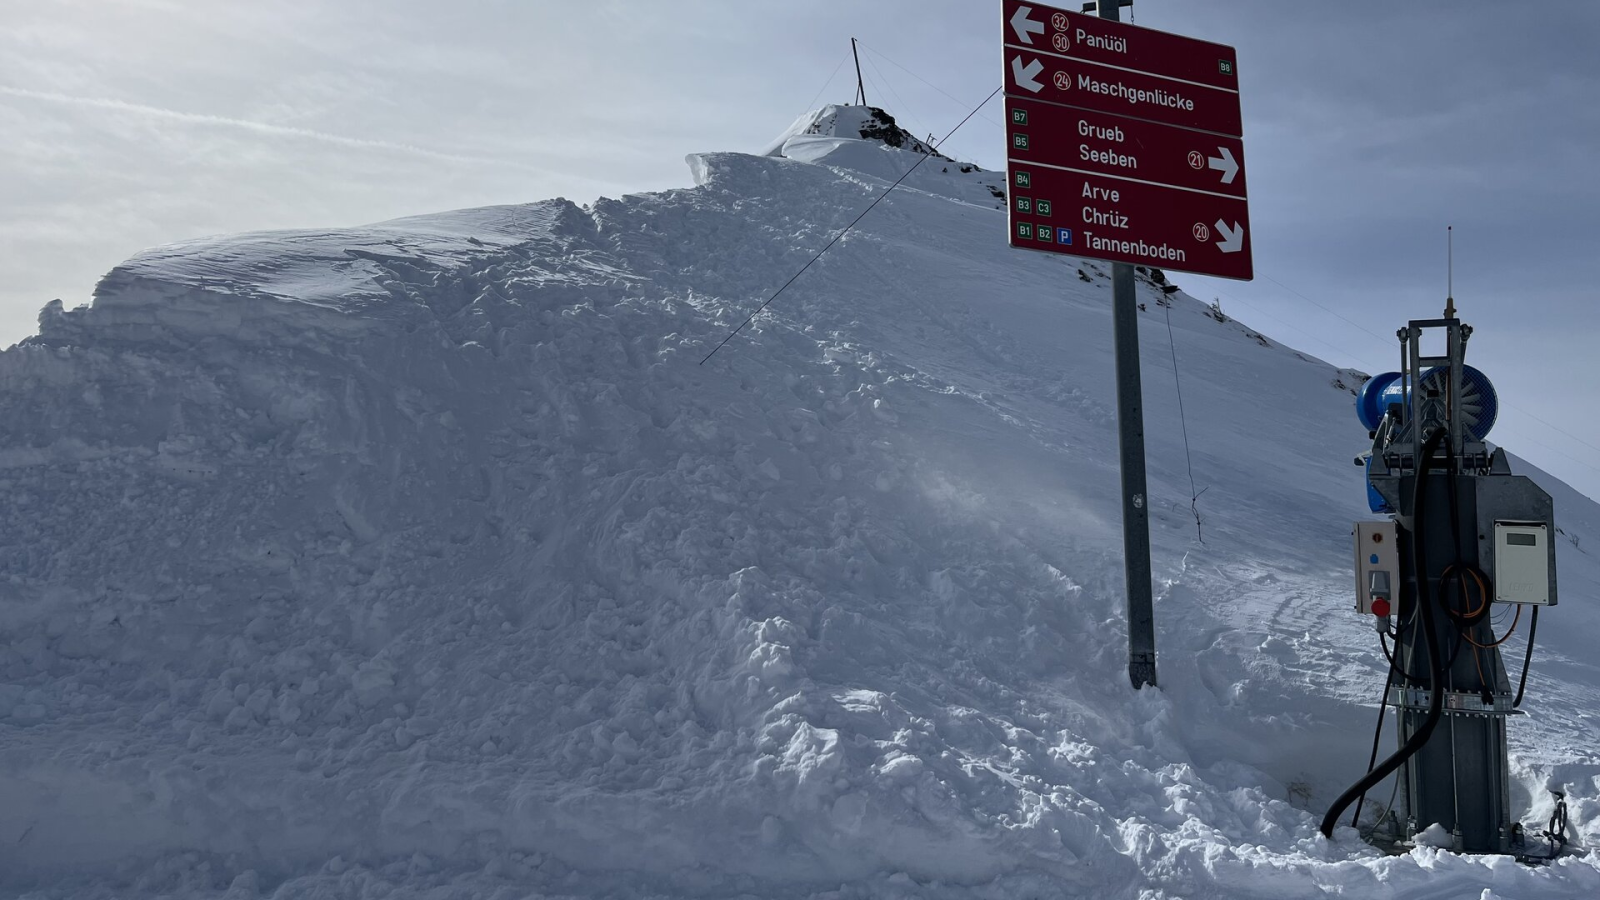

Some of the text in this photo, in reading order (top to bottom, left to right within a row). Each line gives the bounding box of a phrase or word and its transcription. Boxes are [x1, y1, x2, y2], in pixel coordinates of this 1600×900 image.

[1054, 15, 1066, 29] 32
[1054, 35, 1067, 50] 30
[1076, 28, 1127, 53] Panüöl
[1220, 62, 1231, 73] B8
[1056, 73, 1069, 88] 24
[1078, 74, 1194, 111] Maschgenlücke
[1014, 112, 1026, 122] B7
[1078, 120, 1124, 142] Grueb
[1015, 137, 1027, 147] B5
[1079, 144, 1137, 169] Seeben
[1190, 153, 1202, 167] 21
[1017, 175, 1028, 185] B4
[1082, 182, 1120, 203] Arve
[1018, 200, 1030, 210] B3
[1038, 203, 1049, 213] C3
[1082, 206, 1129, 229] Chrüz
[1020, 226, 1030, 236] B1
[1039, 228, 1050, 239] B2
[1060, 231, 1068, 242] P
[1195, 225, 1207, 240] 20
[1084, 231, 1186, 262] Tannenboden
